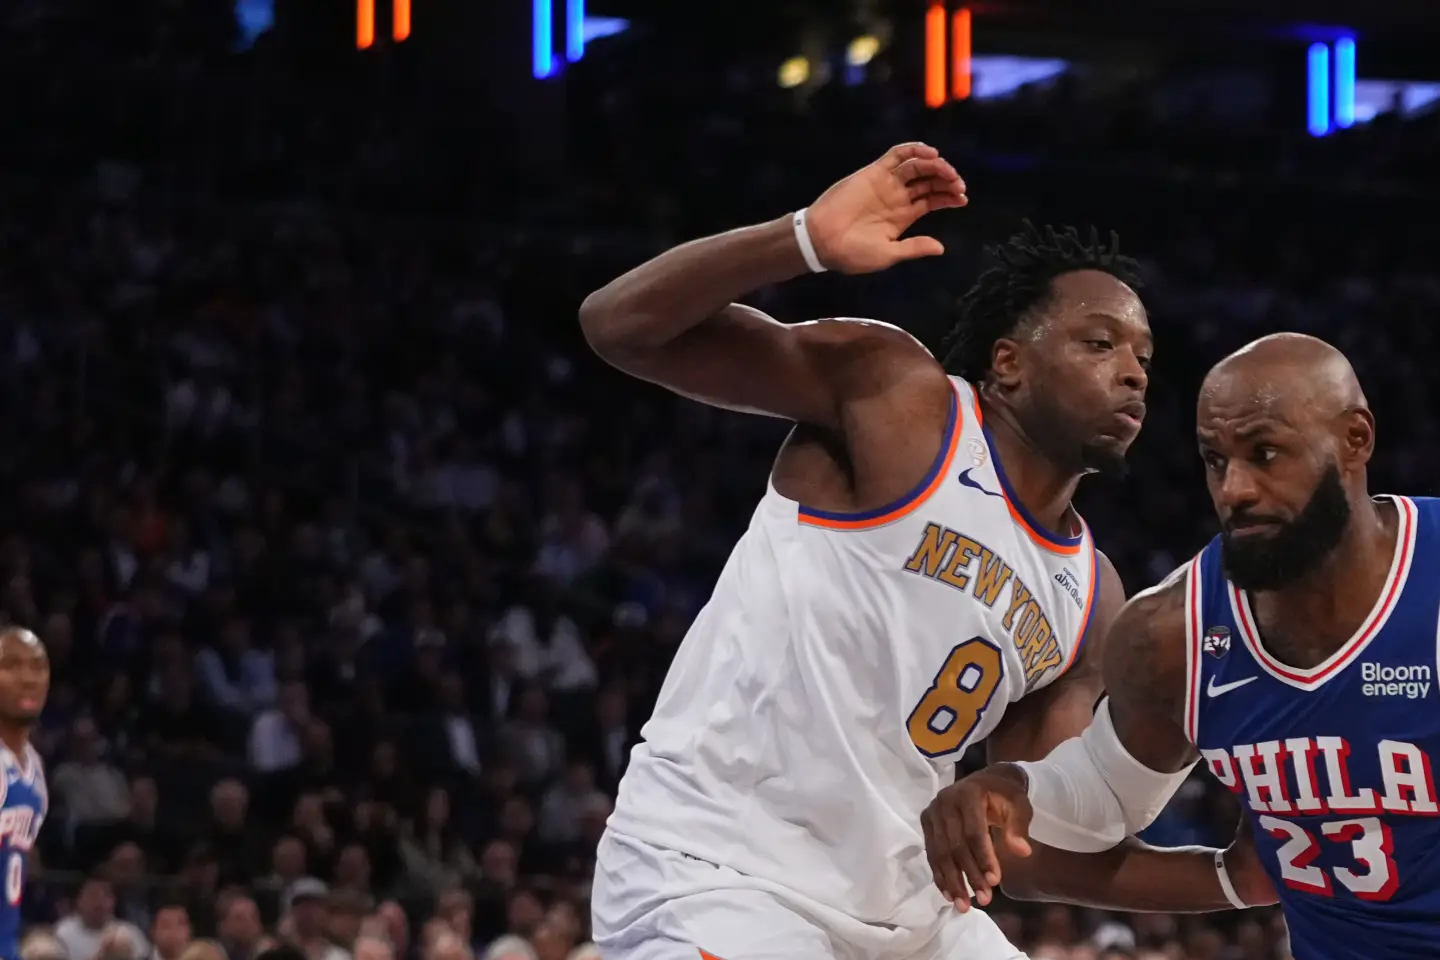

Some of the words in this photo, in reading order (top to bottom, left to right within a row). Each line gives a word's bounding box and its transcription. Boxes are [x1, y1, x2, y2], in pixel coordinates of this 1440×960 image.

[903, 520, 1014, 609] NEW
[1002, 574, 1064, 690] YORK
[905, 636, 1005, 758] 8
[1361, 662, 1431, 681] Bloom
[1361, 681, 1431, 699] energy
[1258, 814, 1400, 901] 23
